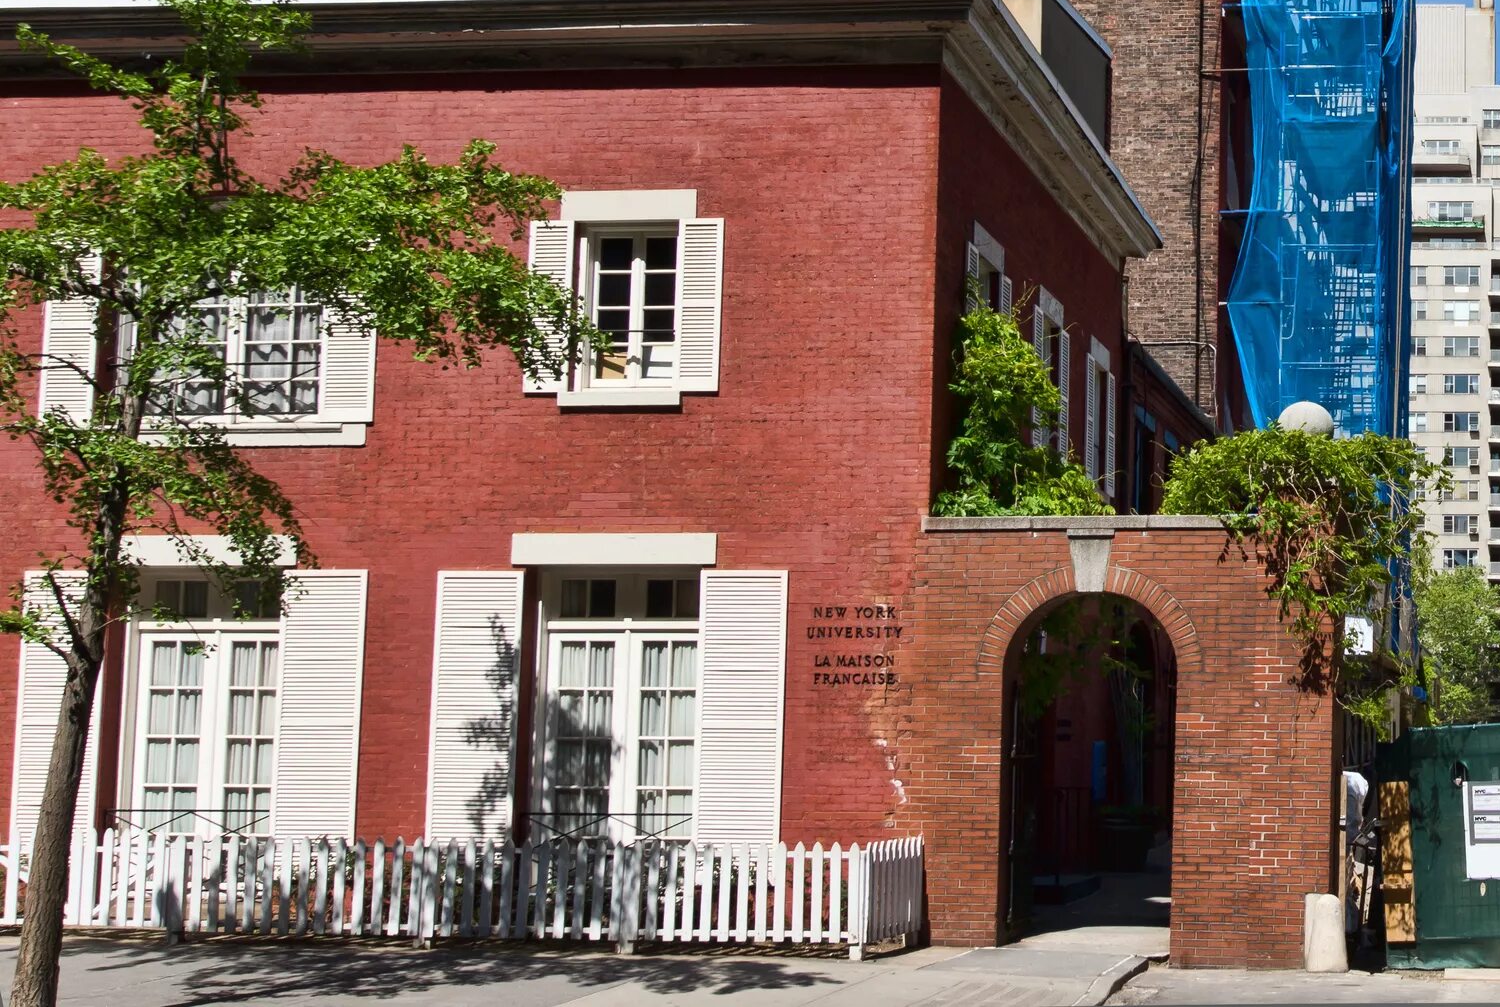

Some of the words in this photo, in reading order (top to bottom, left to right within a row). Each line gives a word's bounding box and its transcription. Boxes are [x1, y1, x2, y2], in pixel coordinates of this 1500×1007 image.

[813, 607, 847, 618] NEW
[855, 607, 896, 619] YORK
[806, 626, 903, 639] UNIVERSITY
[814, 655, 831, 667] LA
[836, 655, 895, 667] MAISON
